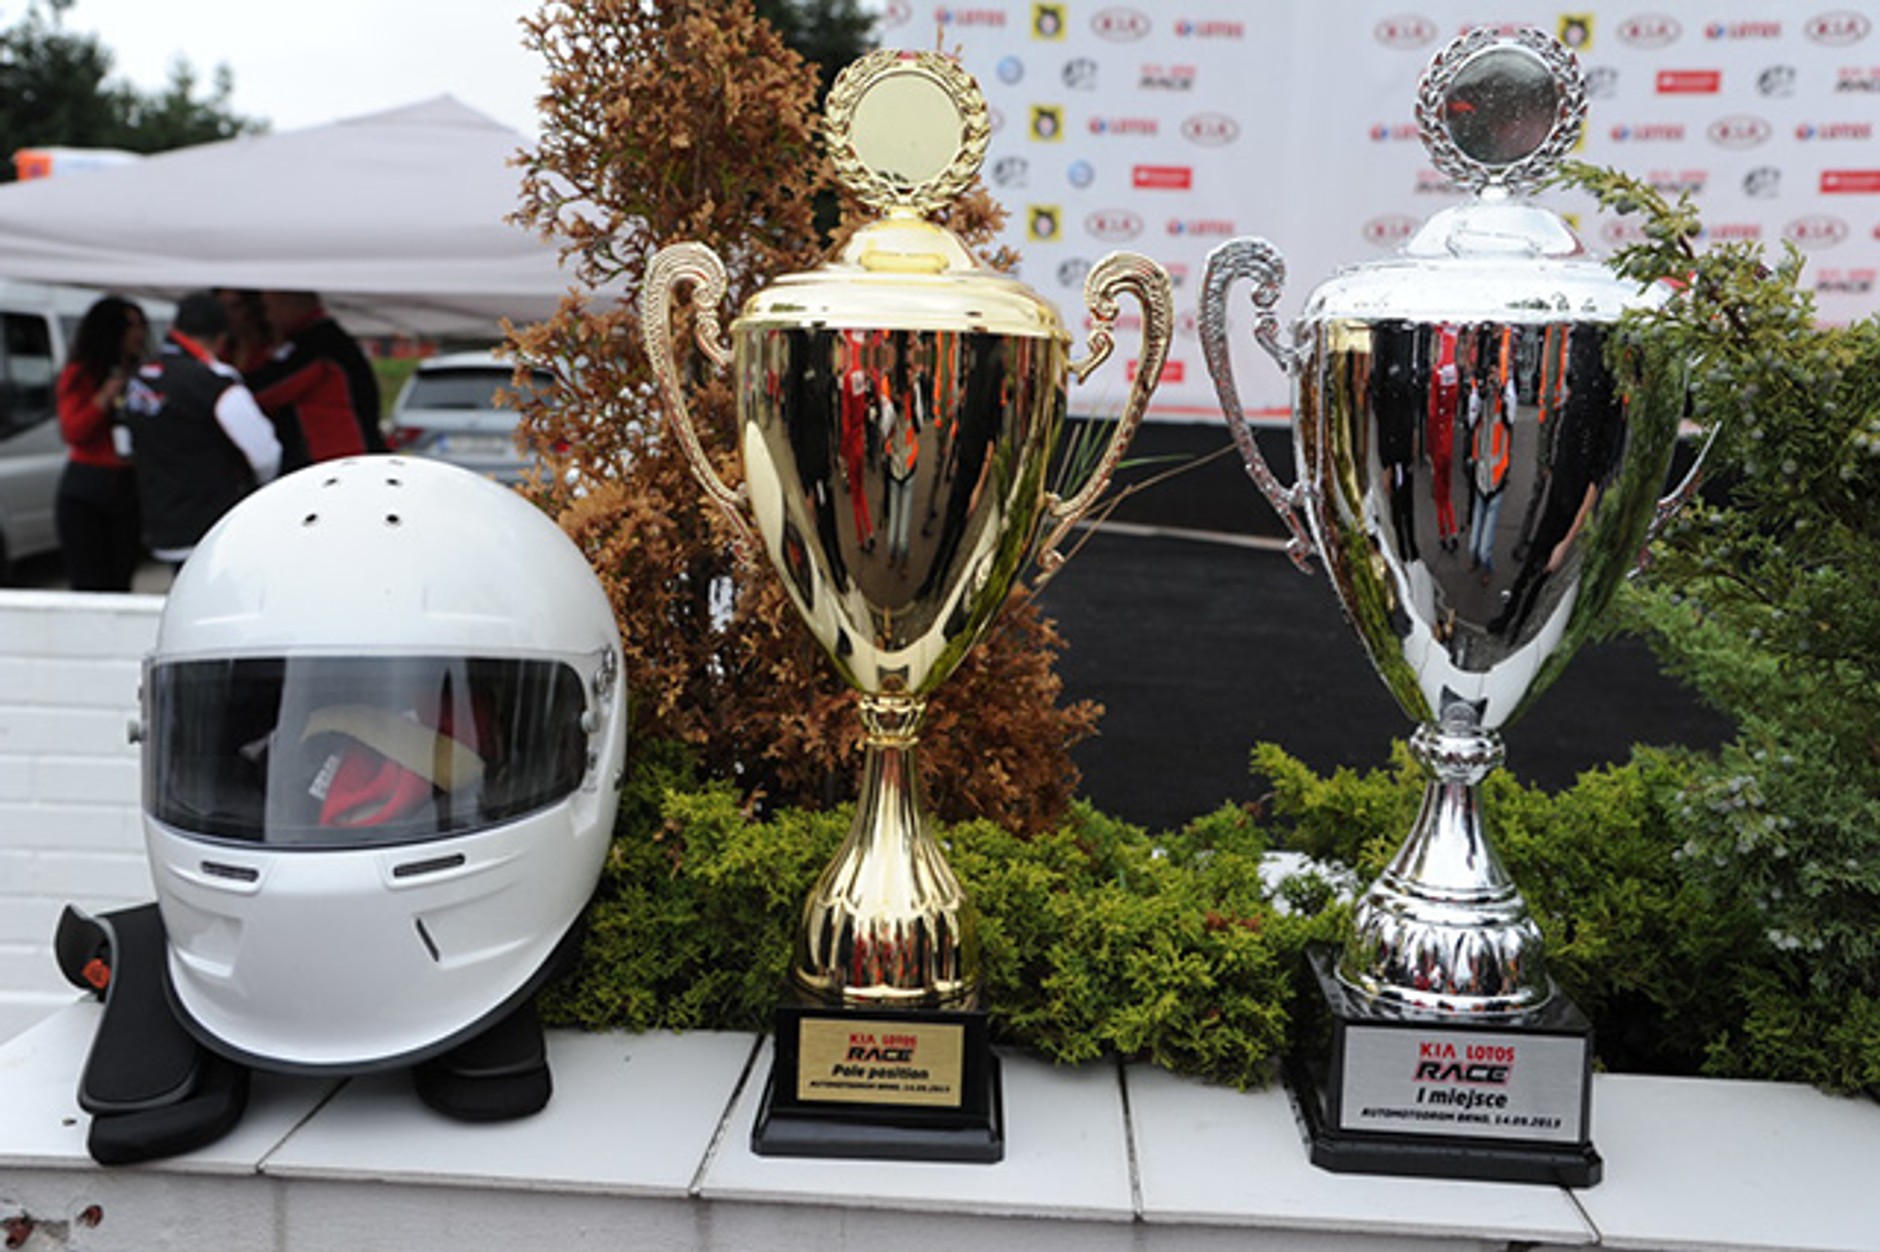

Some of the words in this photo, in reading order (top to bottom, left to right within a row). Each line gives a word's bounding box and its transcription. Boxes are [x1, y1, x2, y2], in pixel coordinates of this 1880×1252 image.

[849, 1033, 876, 1045] KIA
[846, 1046, 915, 1062] RACE
[1419, 1042, 1456, 1059] KIA
[1466, 1044, 1515, 1062] LOTOS
[832, 1064, 863, 1077] Pole
[867, 1066, 930, 1080] position
[1413, 1061, 1512, 1084] RACE
[1416, 1087, 1425, 1103] I
[1428, 1089, 1508, 1110] miejsce
